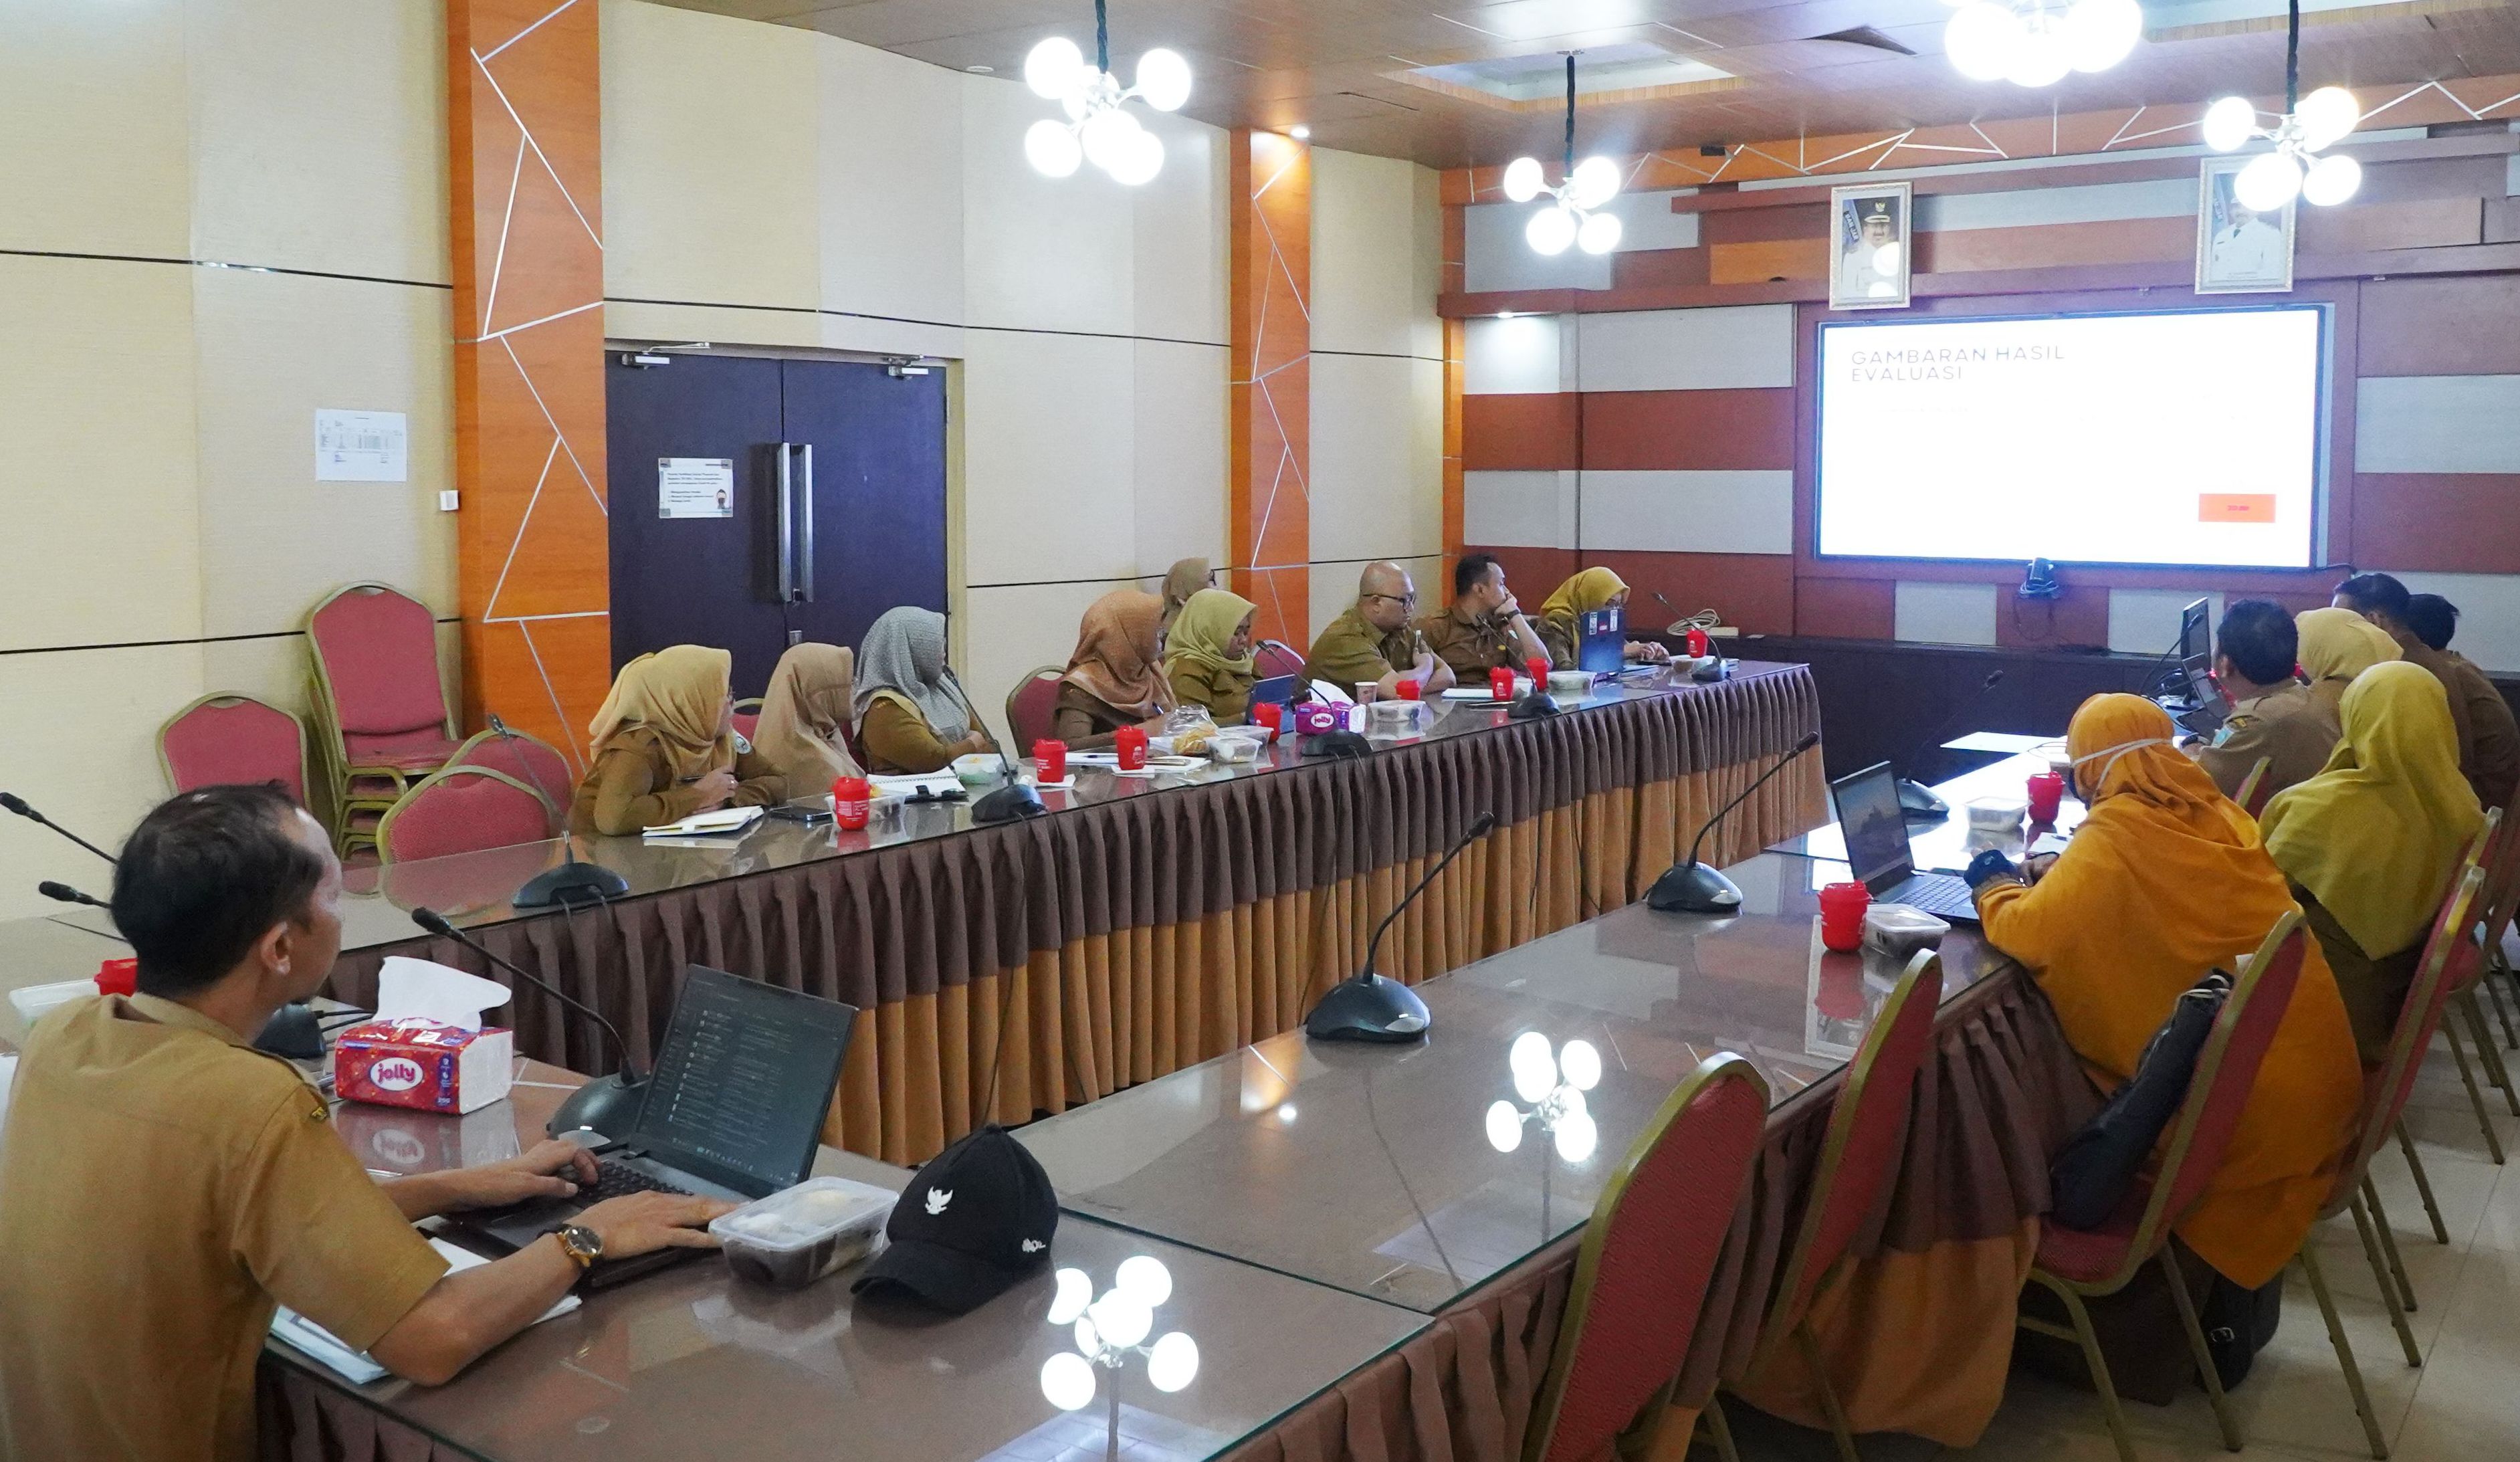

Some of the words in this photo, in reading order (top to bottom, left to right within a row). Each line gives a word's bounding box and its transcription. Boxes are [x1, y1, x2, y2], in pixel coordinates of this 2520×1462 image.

[1851, 347, 1986, 364] GAMBARAN
[1996, 345, 2065, 361] HASIL
[1852, 366, 1962, 382] EVALUASI
[1314, 716, 1330, 724] jolly
[378, 1063, 415, 1083] jolly
